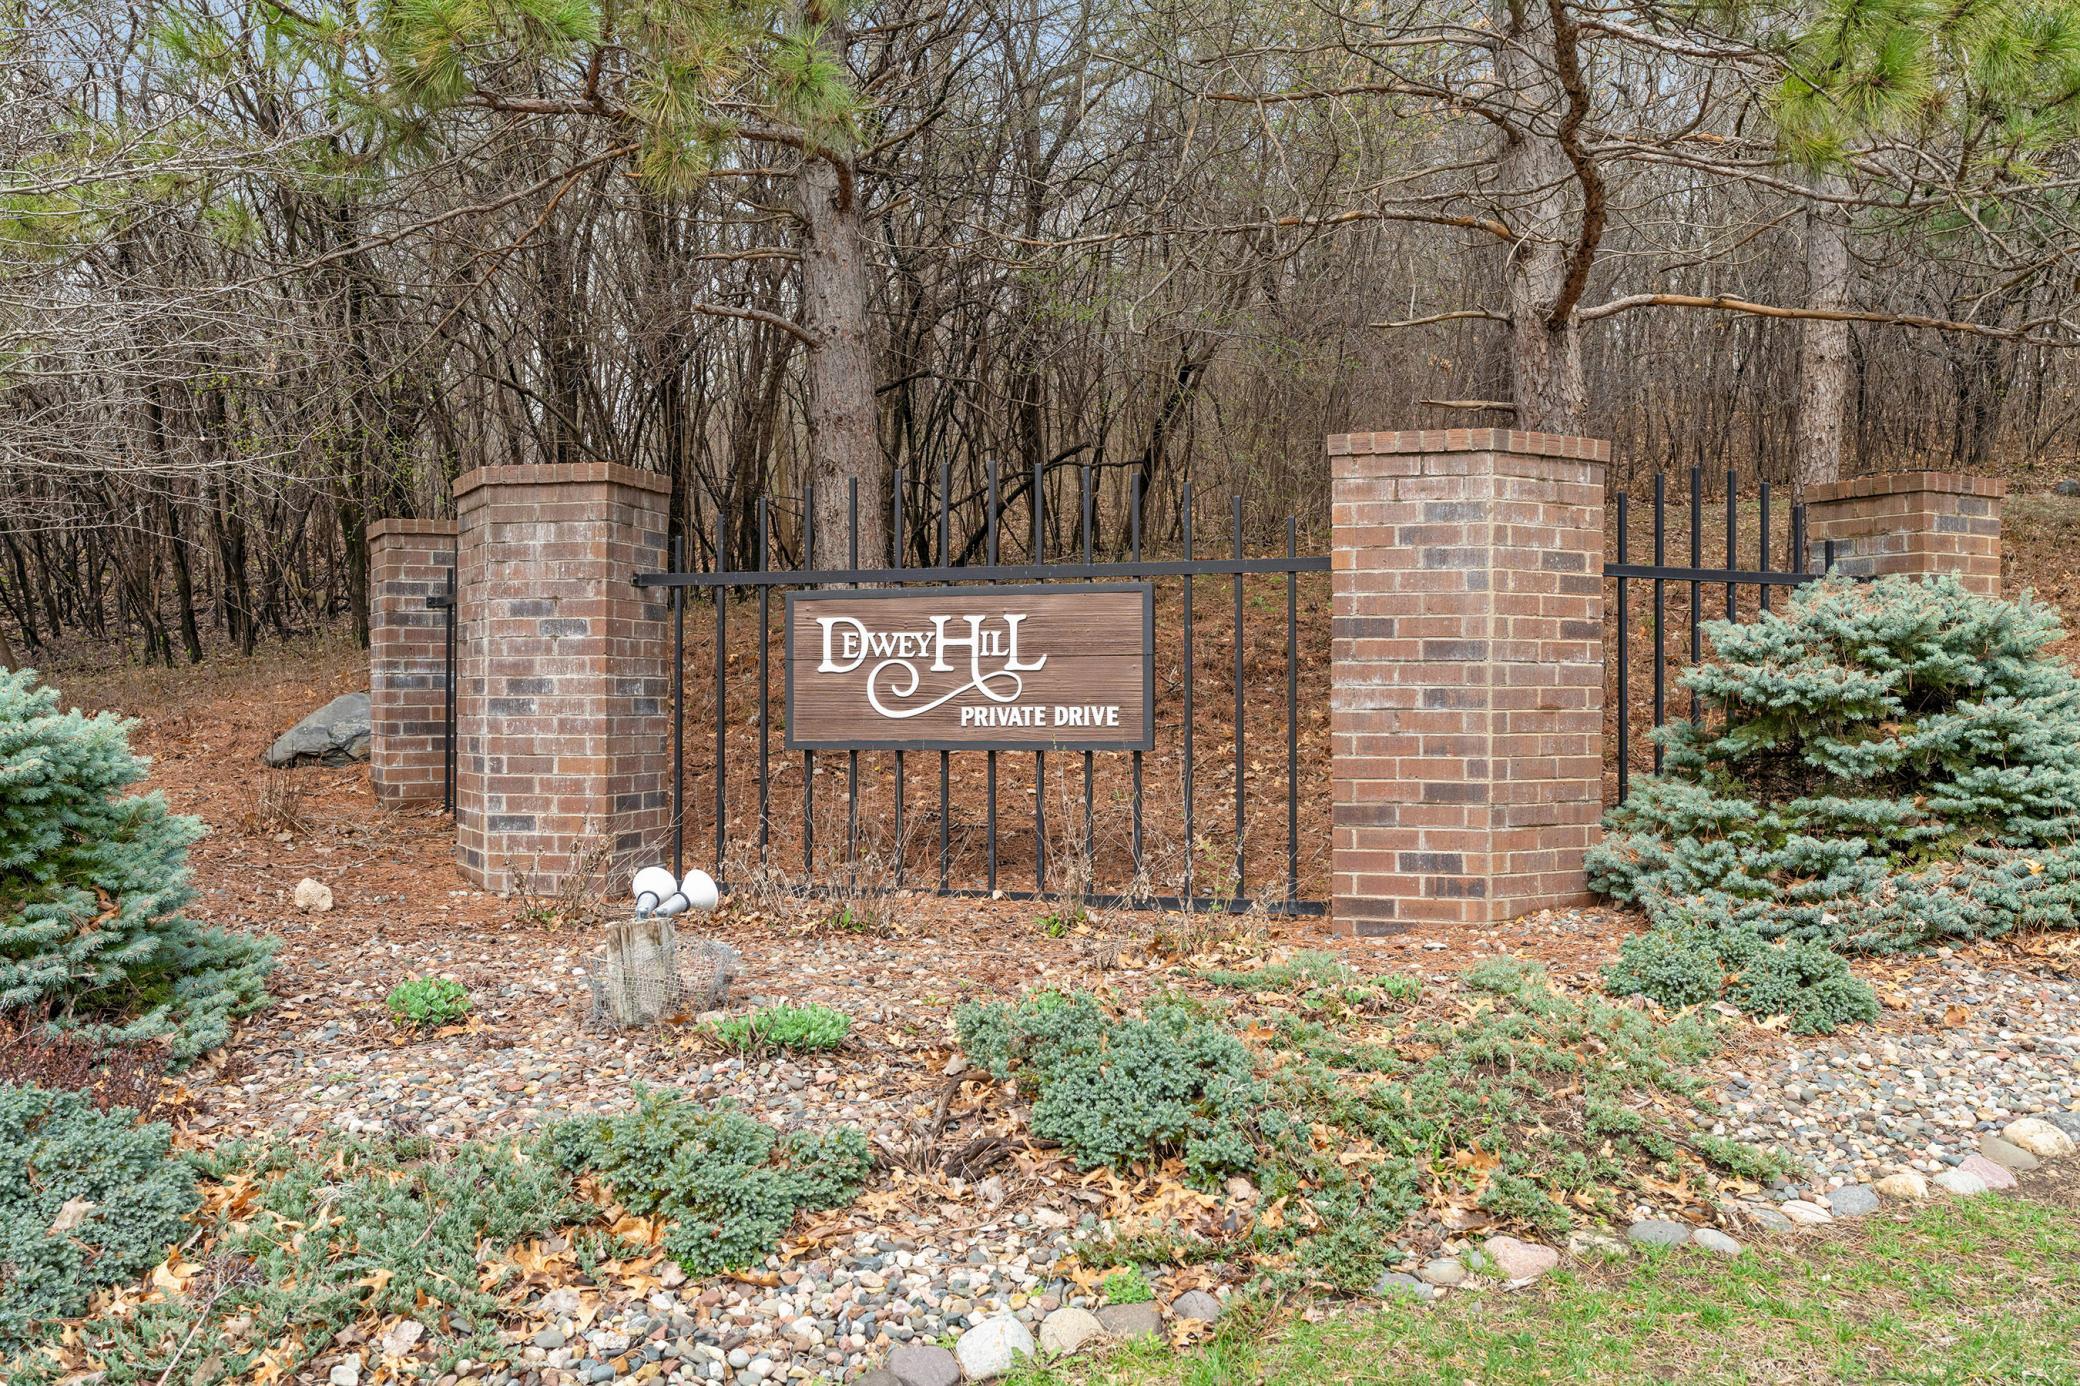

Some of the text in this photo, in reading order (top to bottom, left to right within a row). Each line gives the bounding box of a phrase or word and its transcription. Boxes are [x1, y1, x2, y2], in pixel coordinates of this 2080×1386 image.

[816, 614, 1047, 682] DEWEY HILL
[960, 706, 1120, 727] PRIVATE DRIVE
